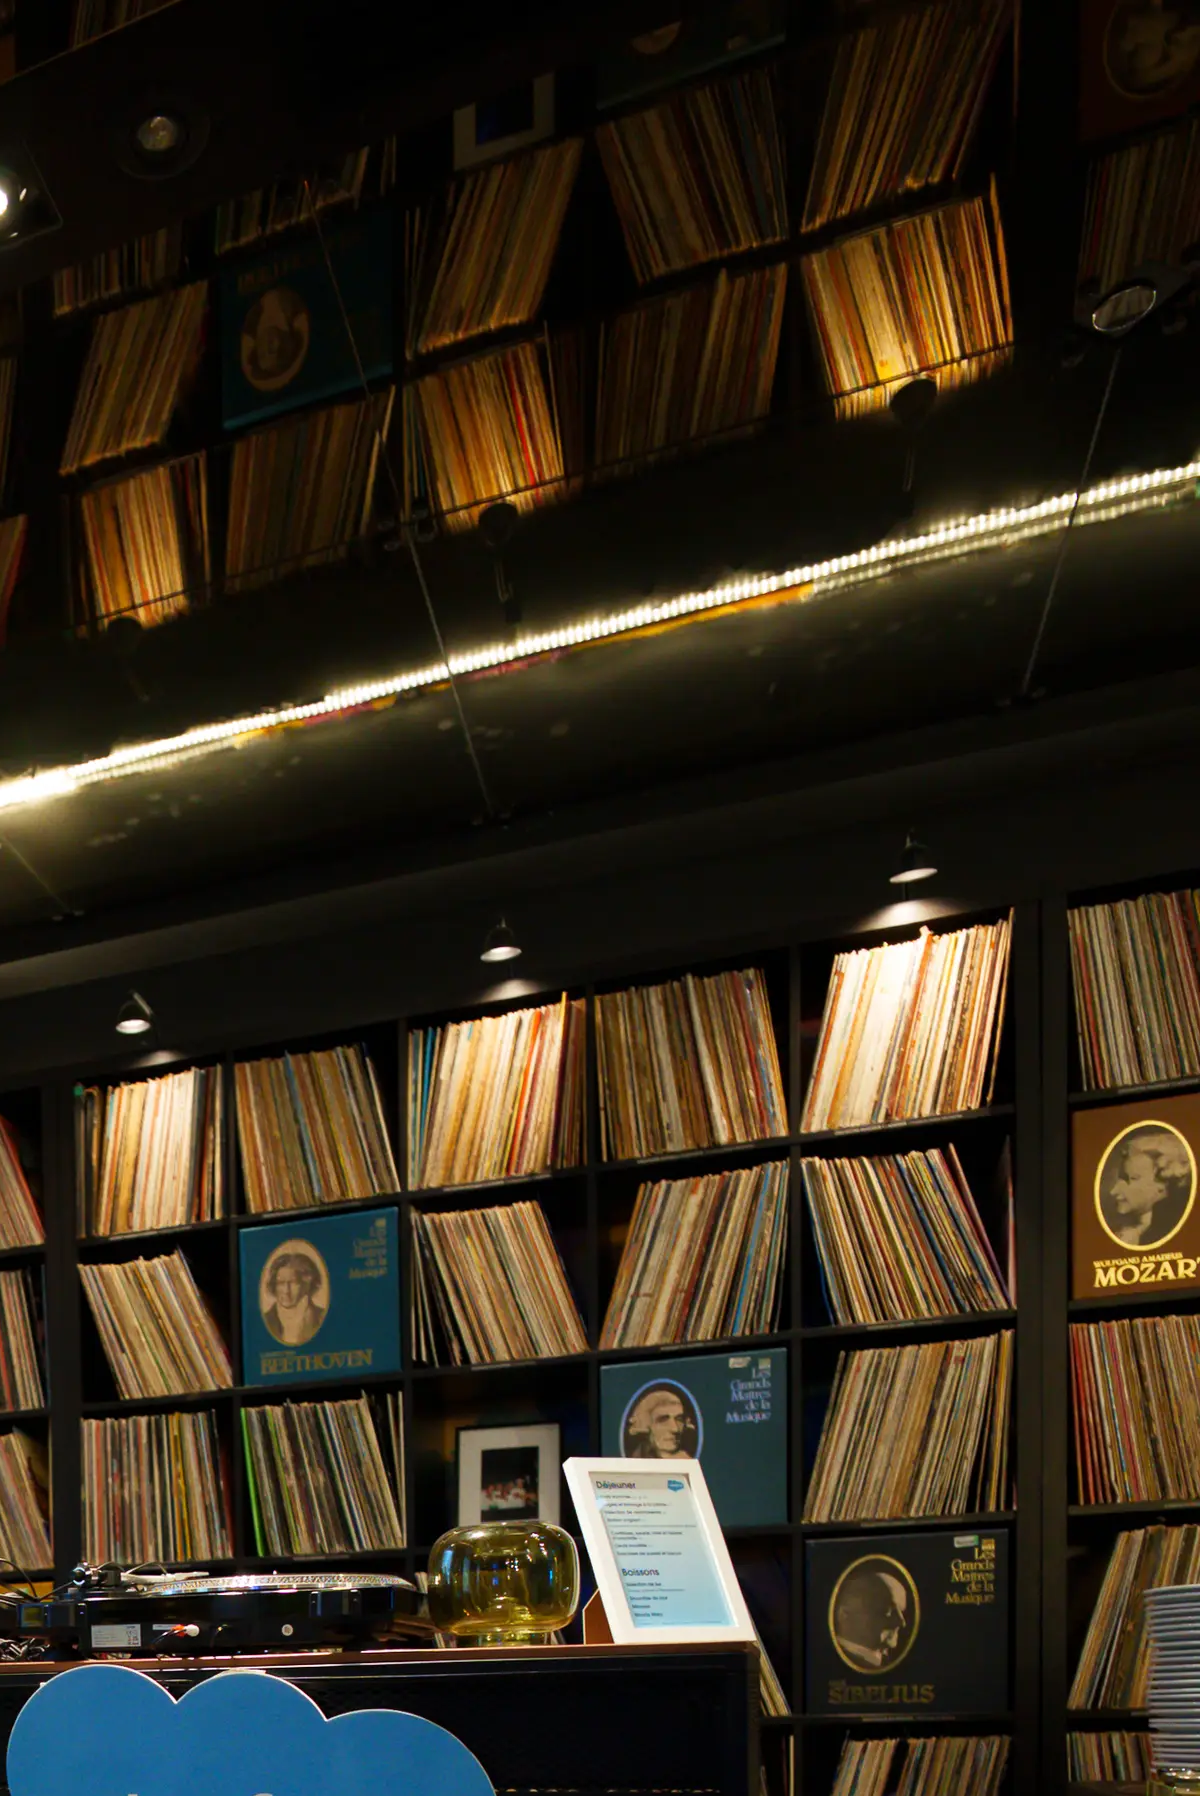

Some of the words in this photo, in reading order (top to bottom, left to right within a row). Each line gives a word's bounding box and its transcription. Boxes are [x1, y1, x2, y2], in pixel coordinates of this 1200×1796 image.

[1093, 1256, 1141, 1268] WOLFGANG
[1141, 1251, 1184, 1263] AMADEUS
[260, 1349, 373, 1376] BEETHOVEN
[752, 1367, 771, 1379] Les
[730, 1378, 771, 1390] Grands
[744, 1400, 759, 1411] de
[760, 1400, 771, 1410] la
[725, 1411, 772, 1424] Musique
[595, 1480, 636, 1490] Déjeuner
[974, 1547, 995, 1560] Les
[951, 1559, 995, 1570] Grands
[621, 1568, 660, 1577] Boissons
[967, 1580, 982, 1592] de
[984, 1580, 994, 1592] la
[944, 1592, 995, 1605] Musique
[827, 1684, 936, 1704] SIBELIUS
